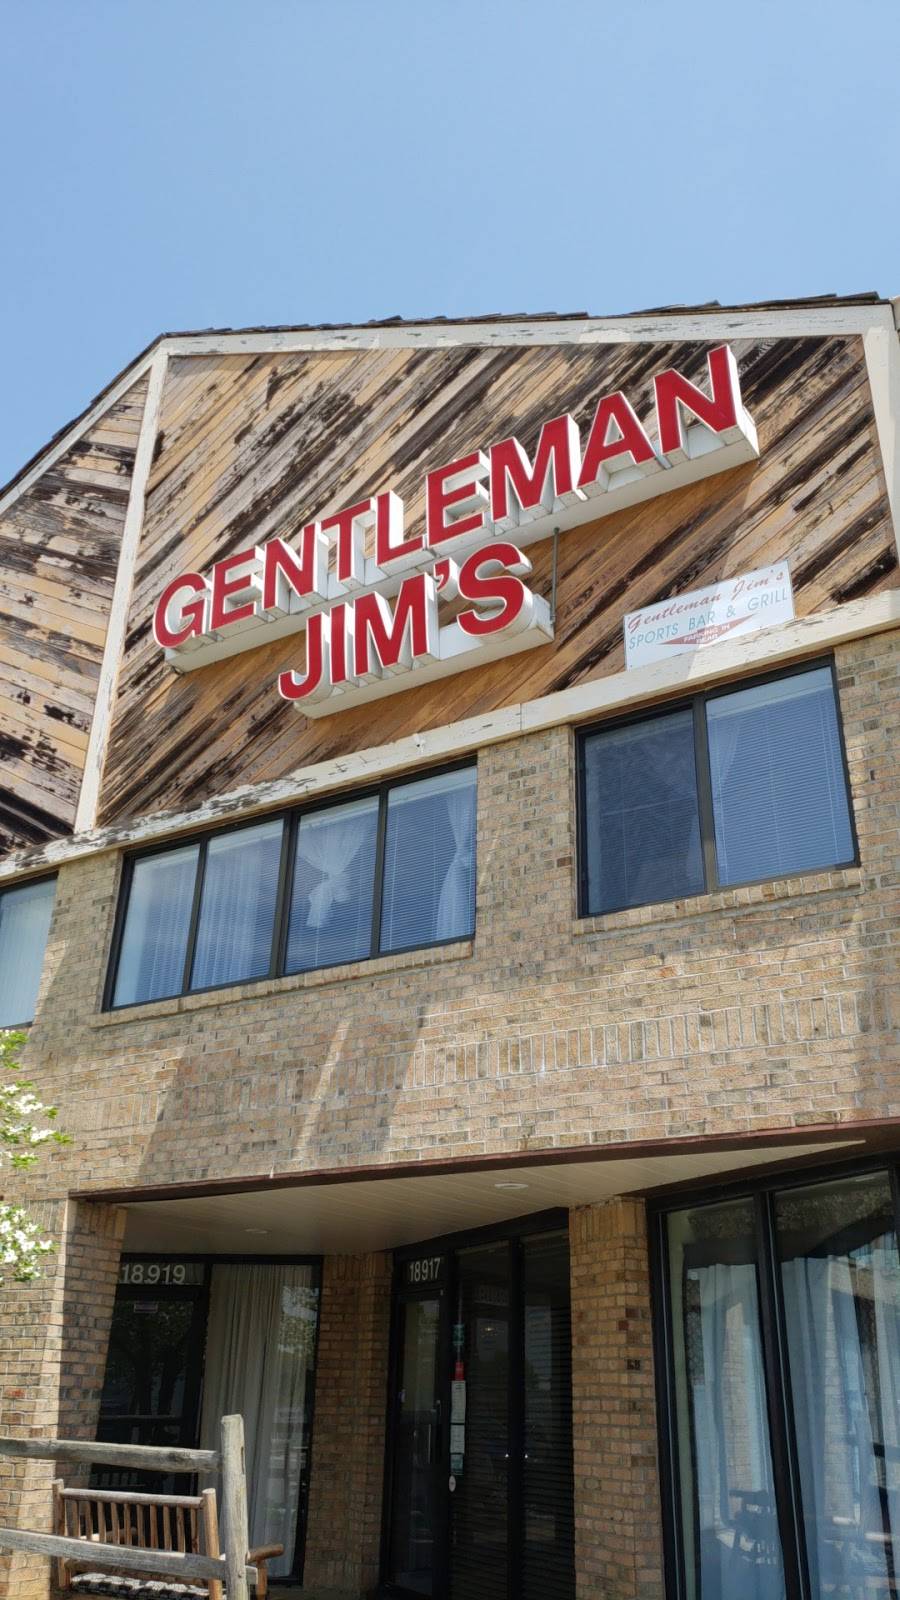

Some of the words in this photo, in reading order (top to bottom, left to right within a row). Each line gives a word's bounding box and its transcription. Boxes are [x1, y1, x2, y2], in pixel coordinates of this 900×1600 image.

[153, 344, 738, 648] GENTLEMAN
[278, 542, 525, 700] JIM'S
[627, 593, 721, 634] Gentleman
[732, 569, 784, 601] Jim's
[628, 623, 679, 650] SPORTS
[688, 610, 716, 631] BAR
[726, 605, 737, 618] &
[747, 588, 788, 612] GRILL
[121, 1263, 186, 1285] 18919
[409, 1257, 441, 1282] 18917
